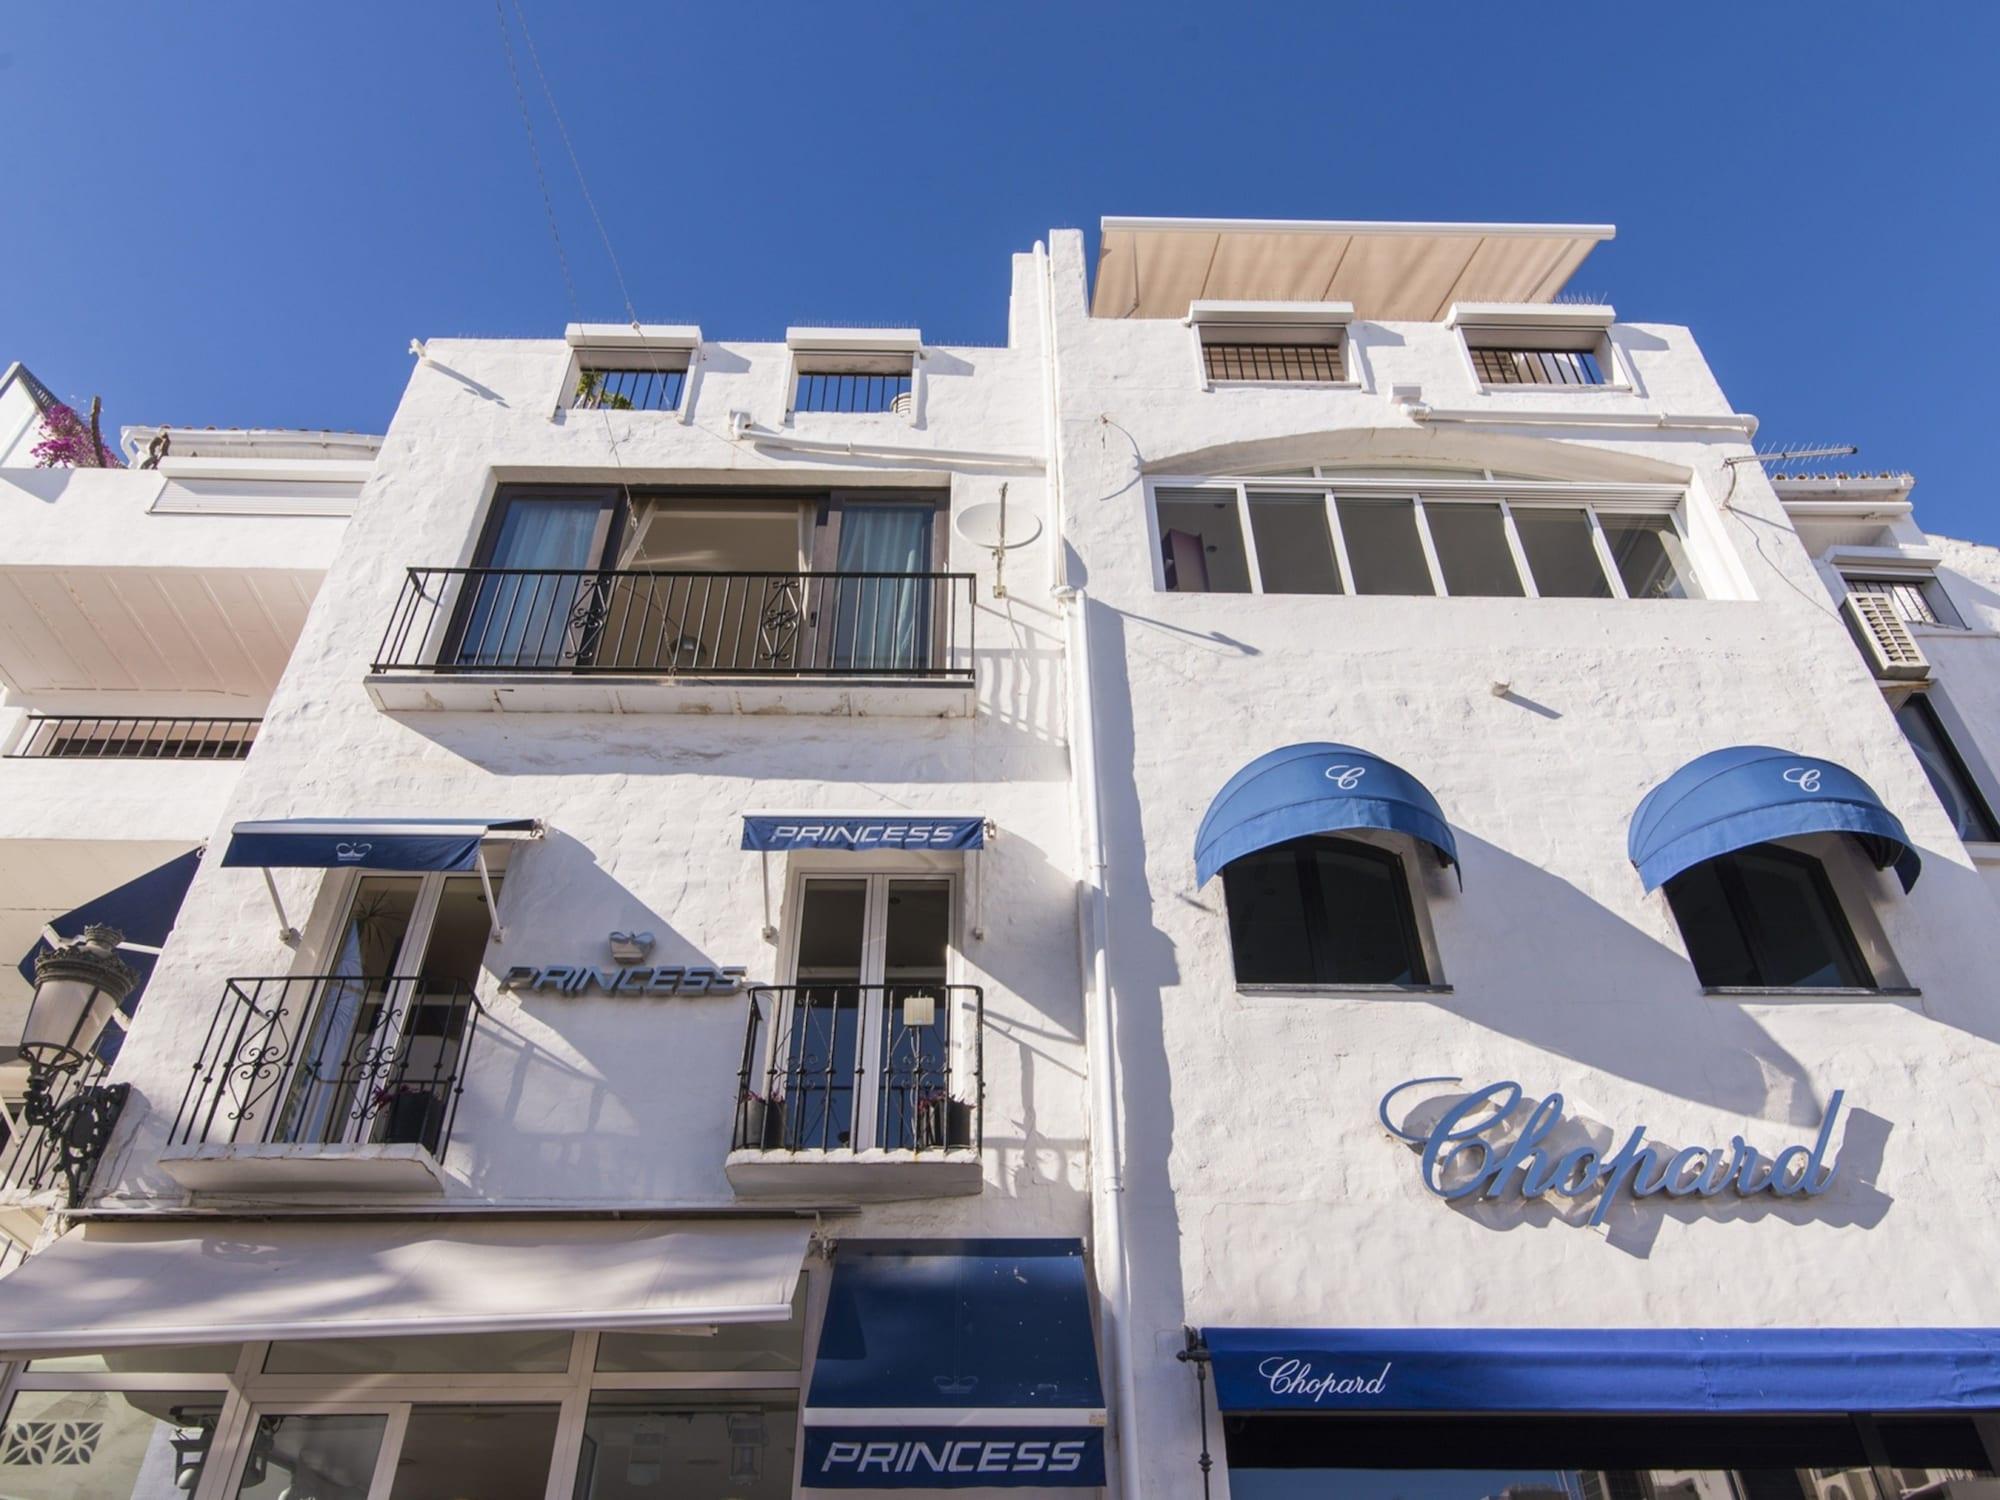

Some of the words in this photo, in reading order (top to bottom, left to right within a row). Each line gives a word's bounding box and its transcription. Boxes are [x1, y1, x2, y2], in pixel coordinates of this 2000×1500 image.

[769, 825, 959, 844] PRINCESS
[498, 966, 748, 997] PRINCESS
[1380, 1076, 1845, 1227] Chopard
[1258, 1356, 1392, 1402] Chopard
[820, 1441, 1085, 1472] PRINCESS
